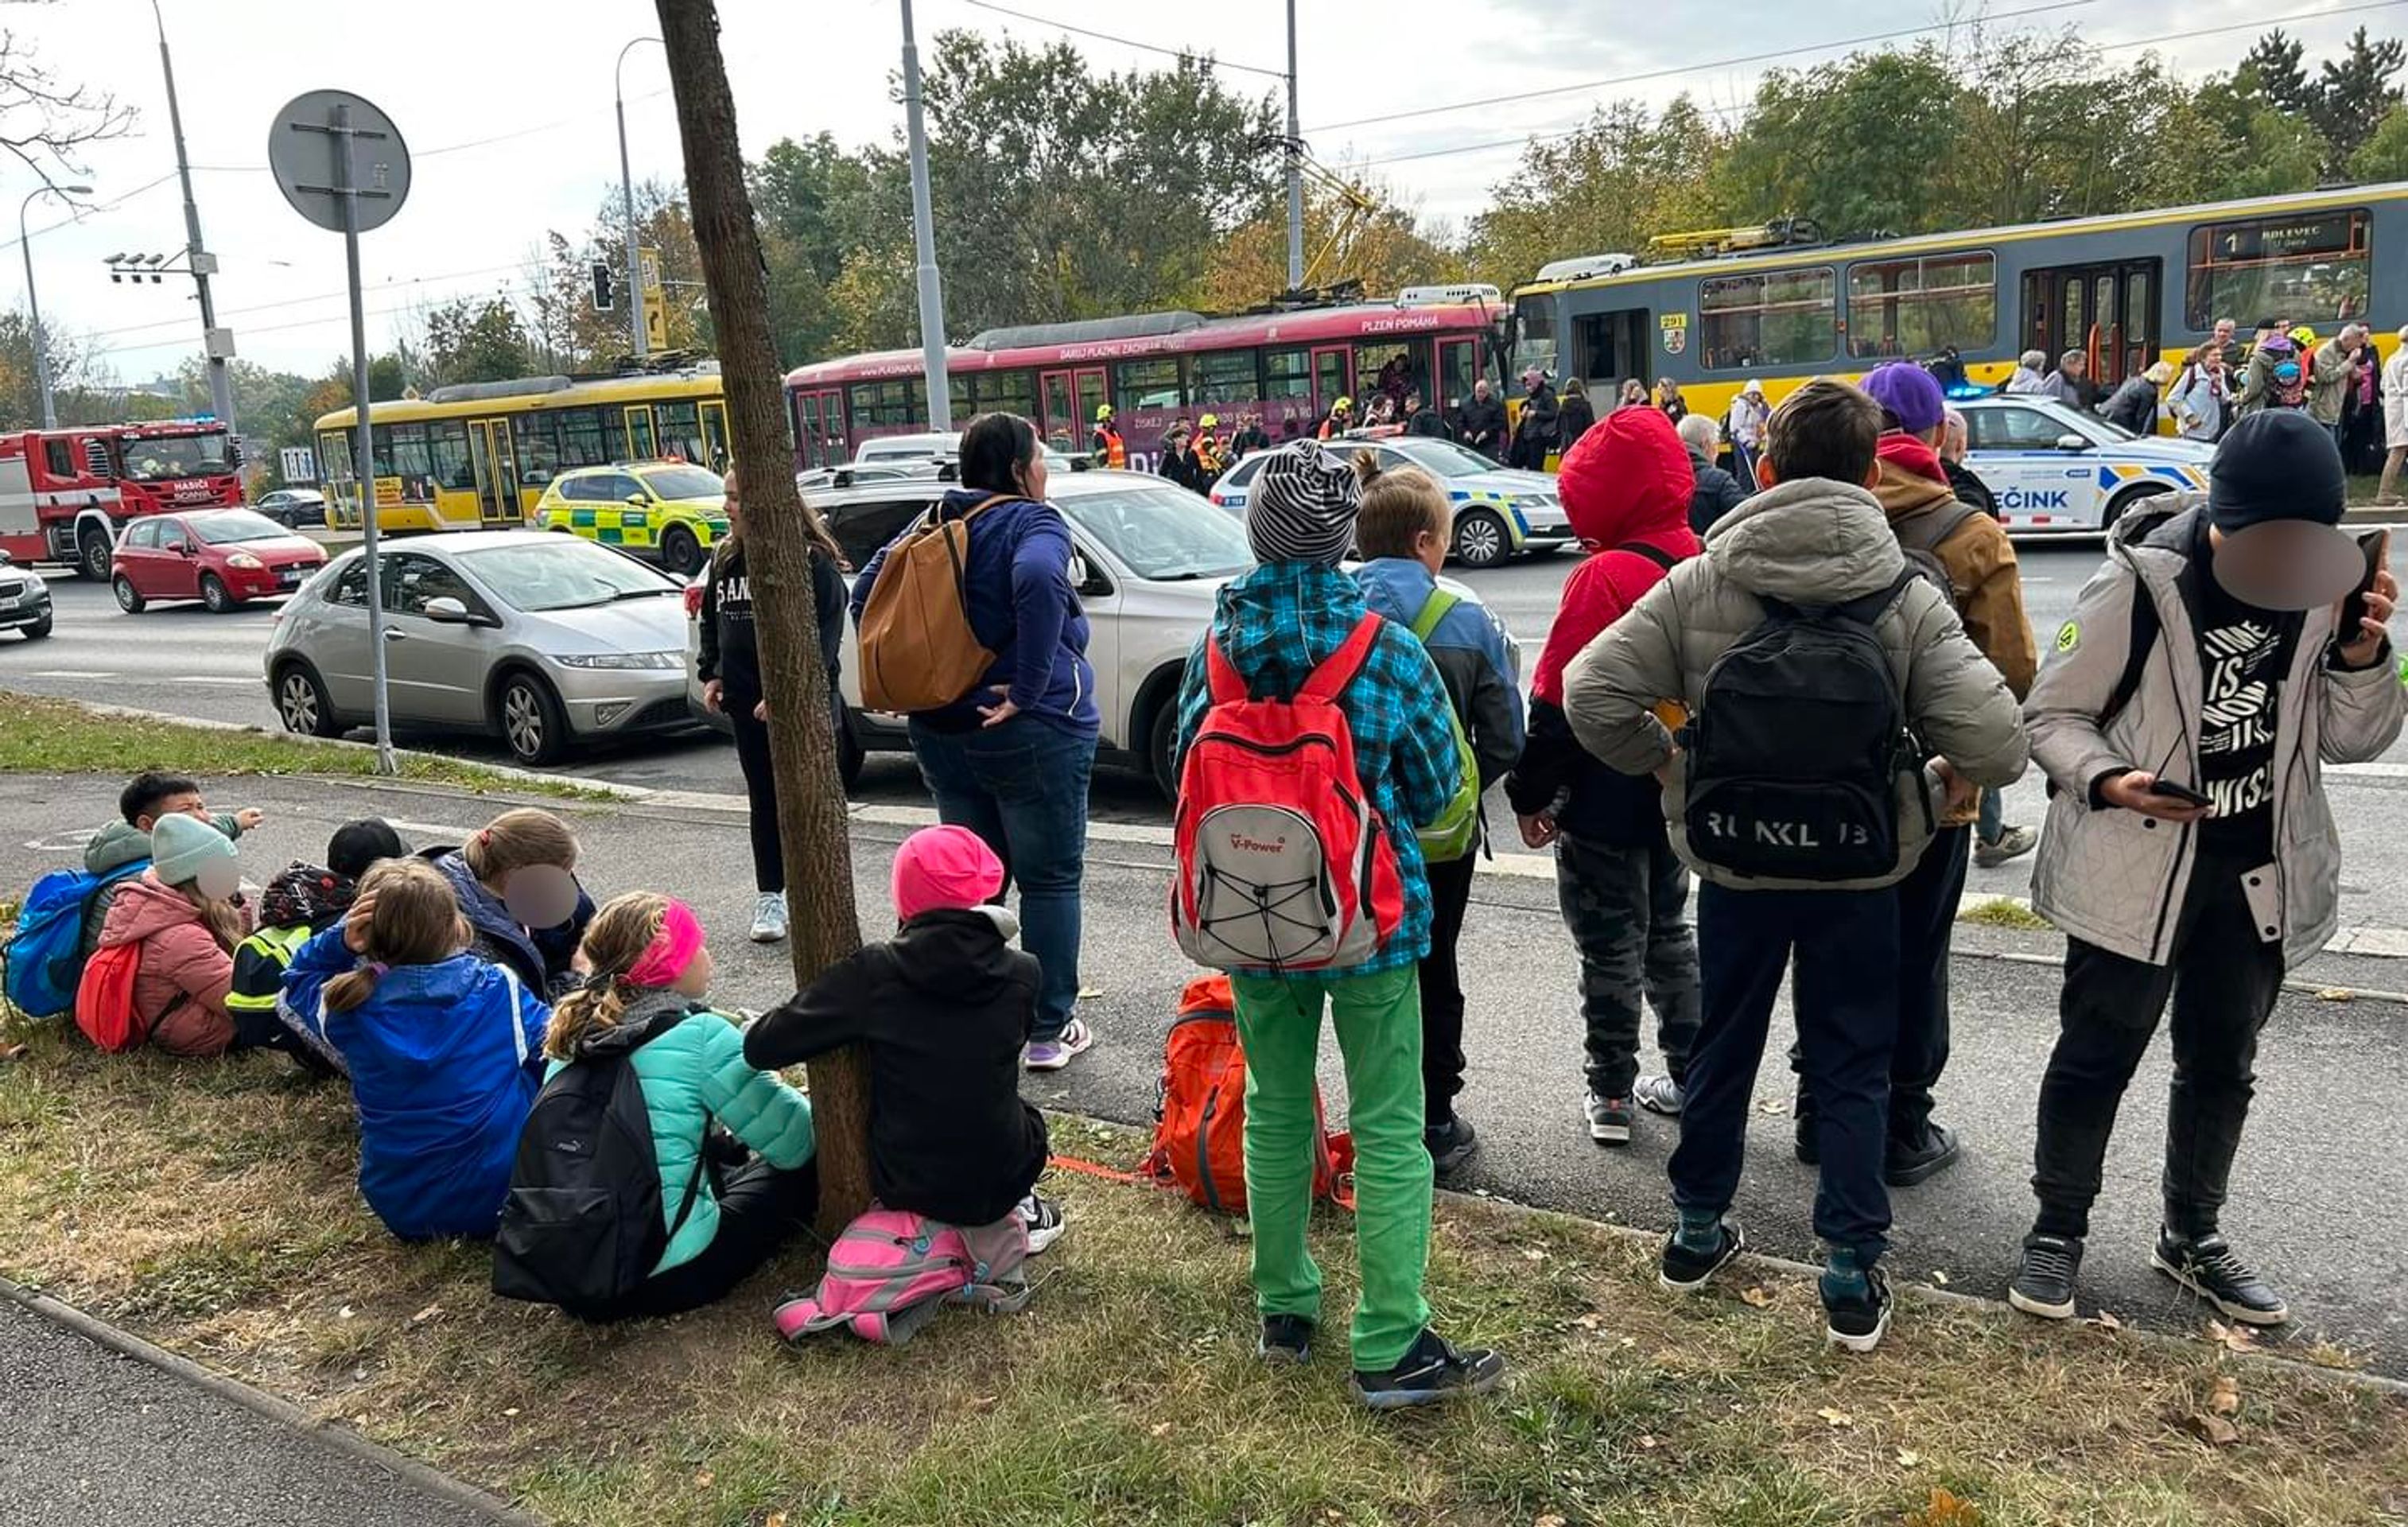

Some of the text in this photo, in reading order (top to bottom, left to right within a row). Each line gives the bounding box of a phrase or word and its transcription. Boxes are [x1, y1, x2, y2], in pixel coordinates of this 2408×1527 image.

[1662, 317, 1683, 328] 291
[173, 479, 208, 492] HASIČI
[2208, 656, 2243, 701] IS
